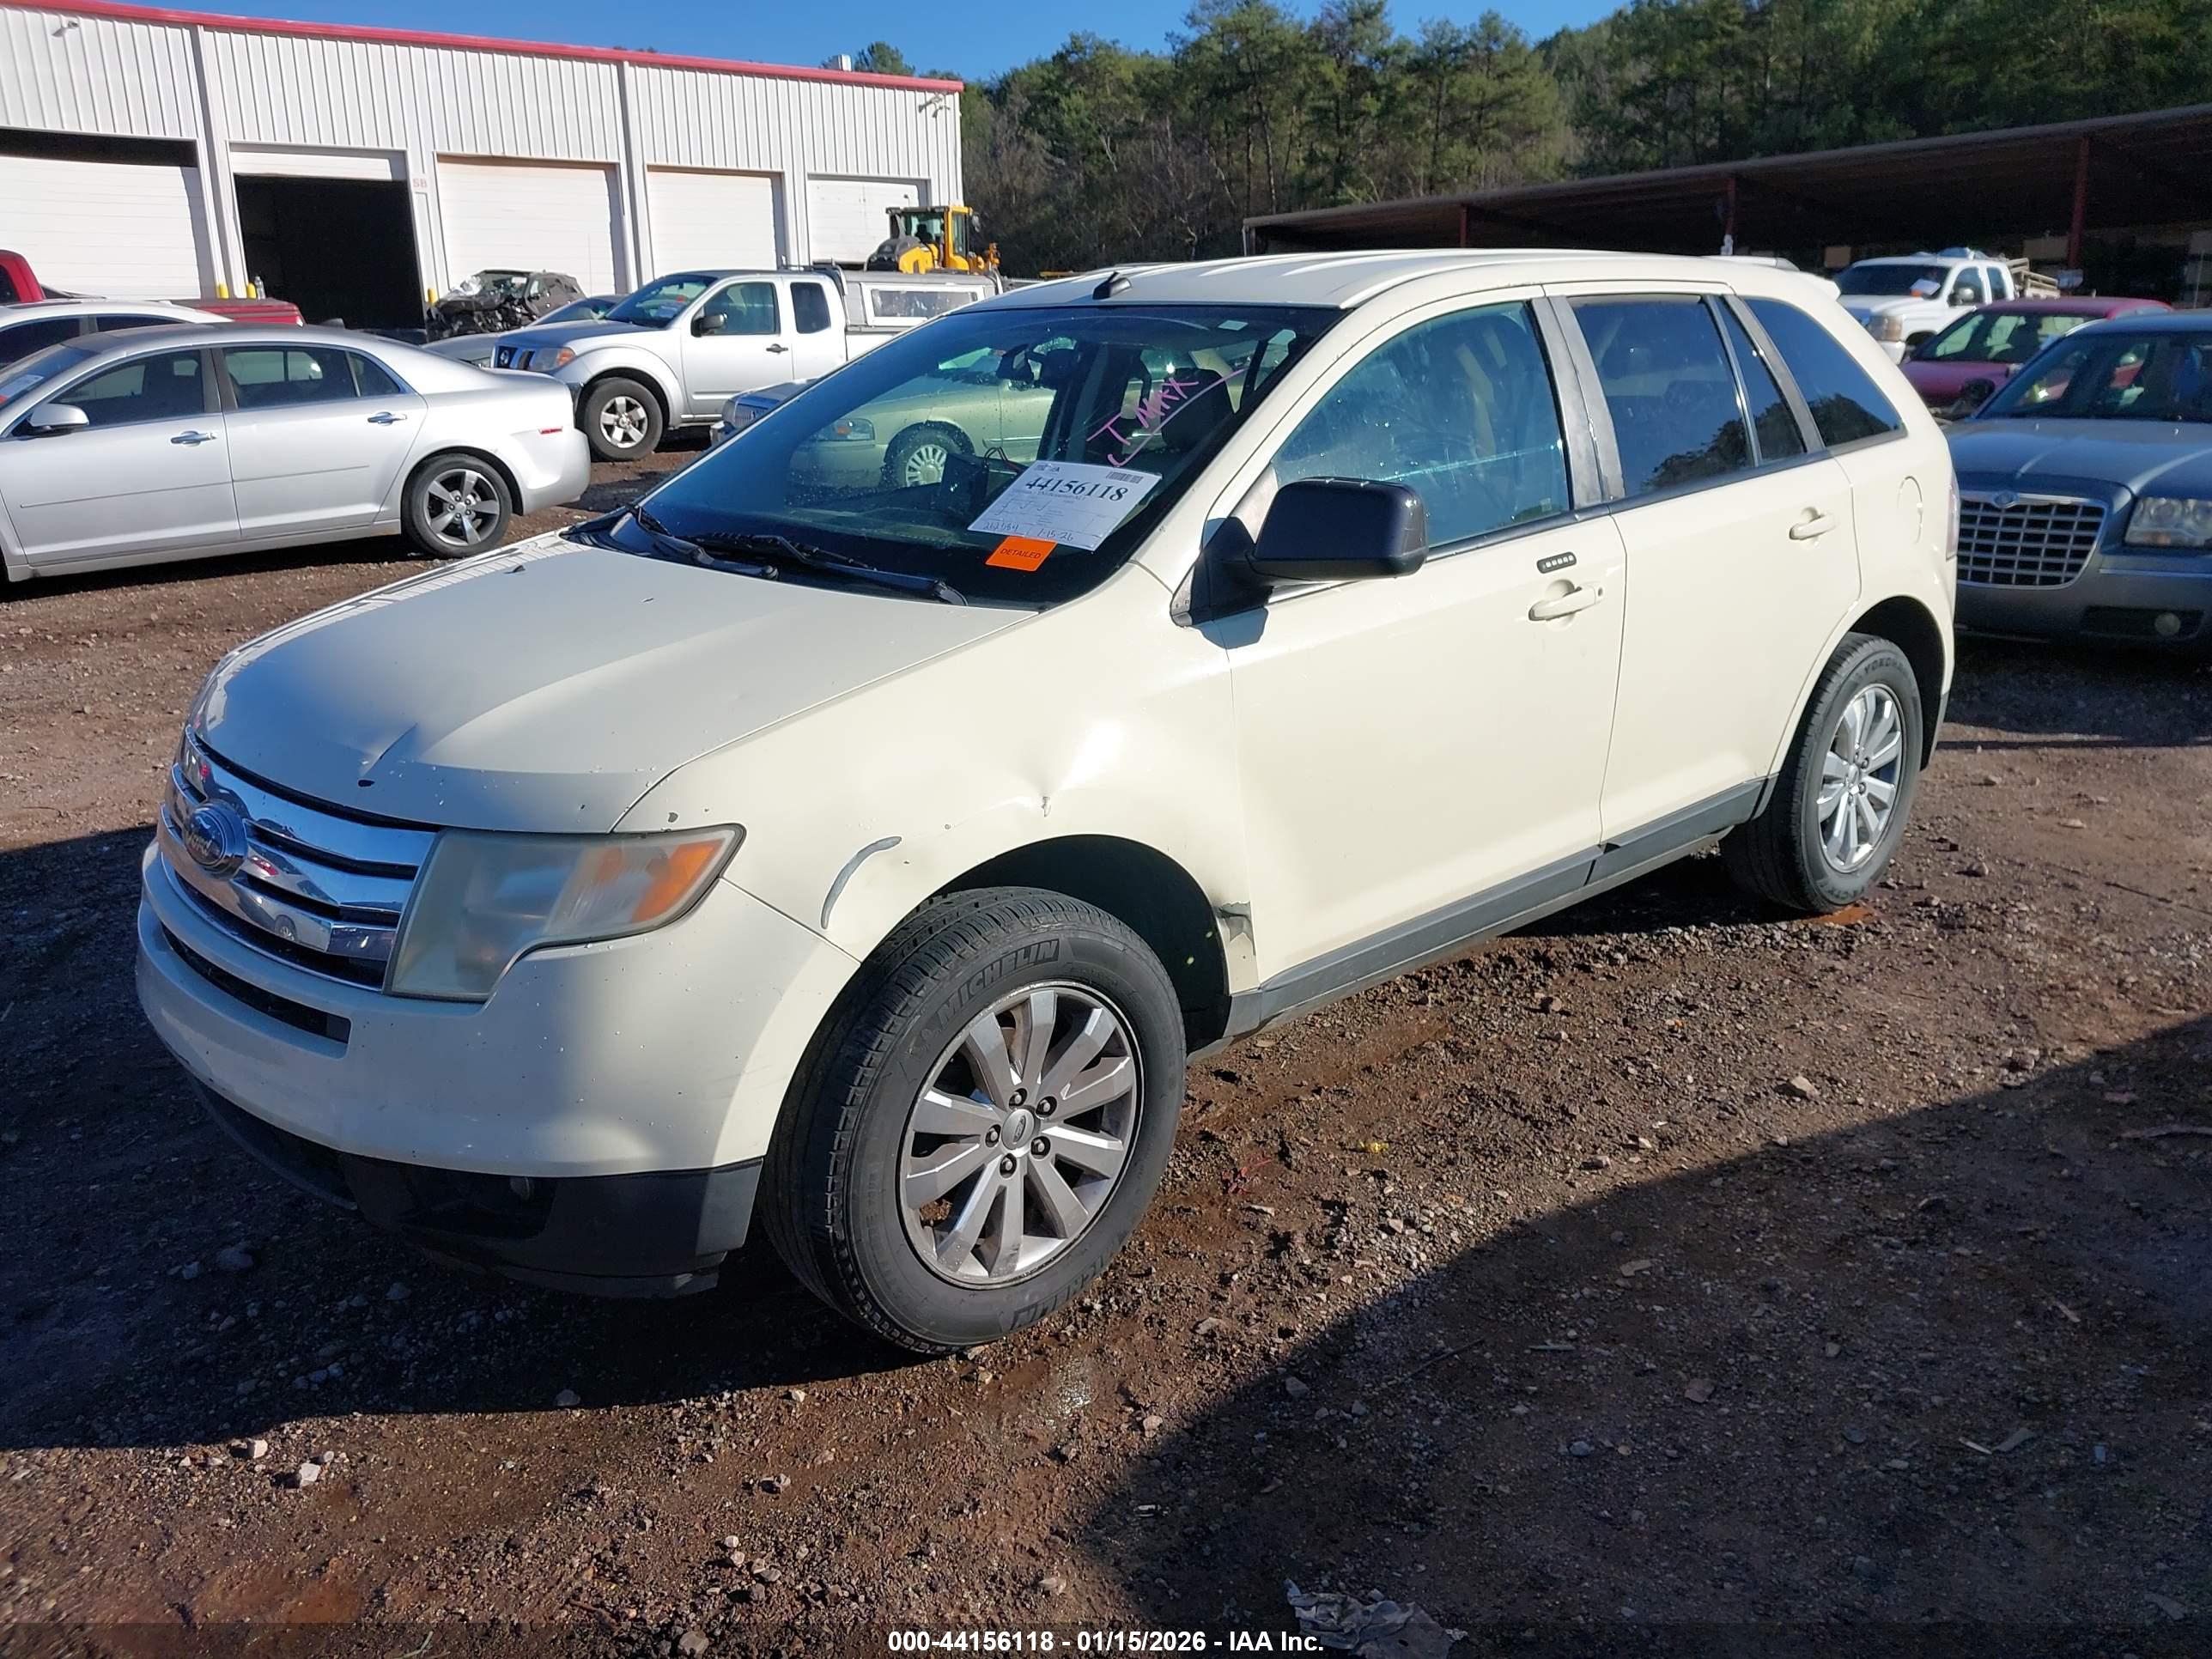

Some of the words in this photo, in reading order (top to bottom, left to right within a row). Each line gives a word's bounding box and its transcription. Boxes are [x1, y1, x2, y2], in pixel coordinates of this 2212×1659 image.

[1025, 477, 1128, 501] 44156118
[1000, 548, 1042, 559] DETAILED
[937, 939, 1059, 1028] MICHELIN
